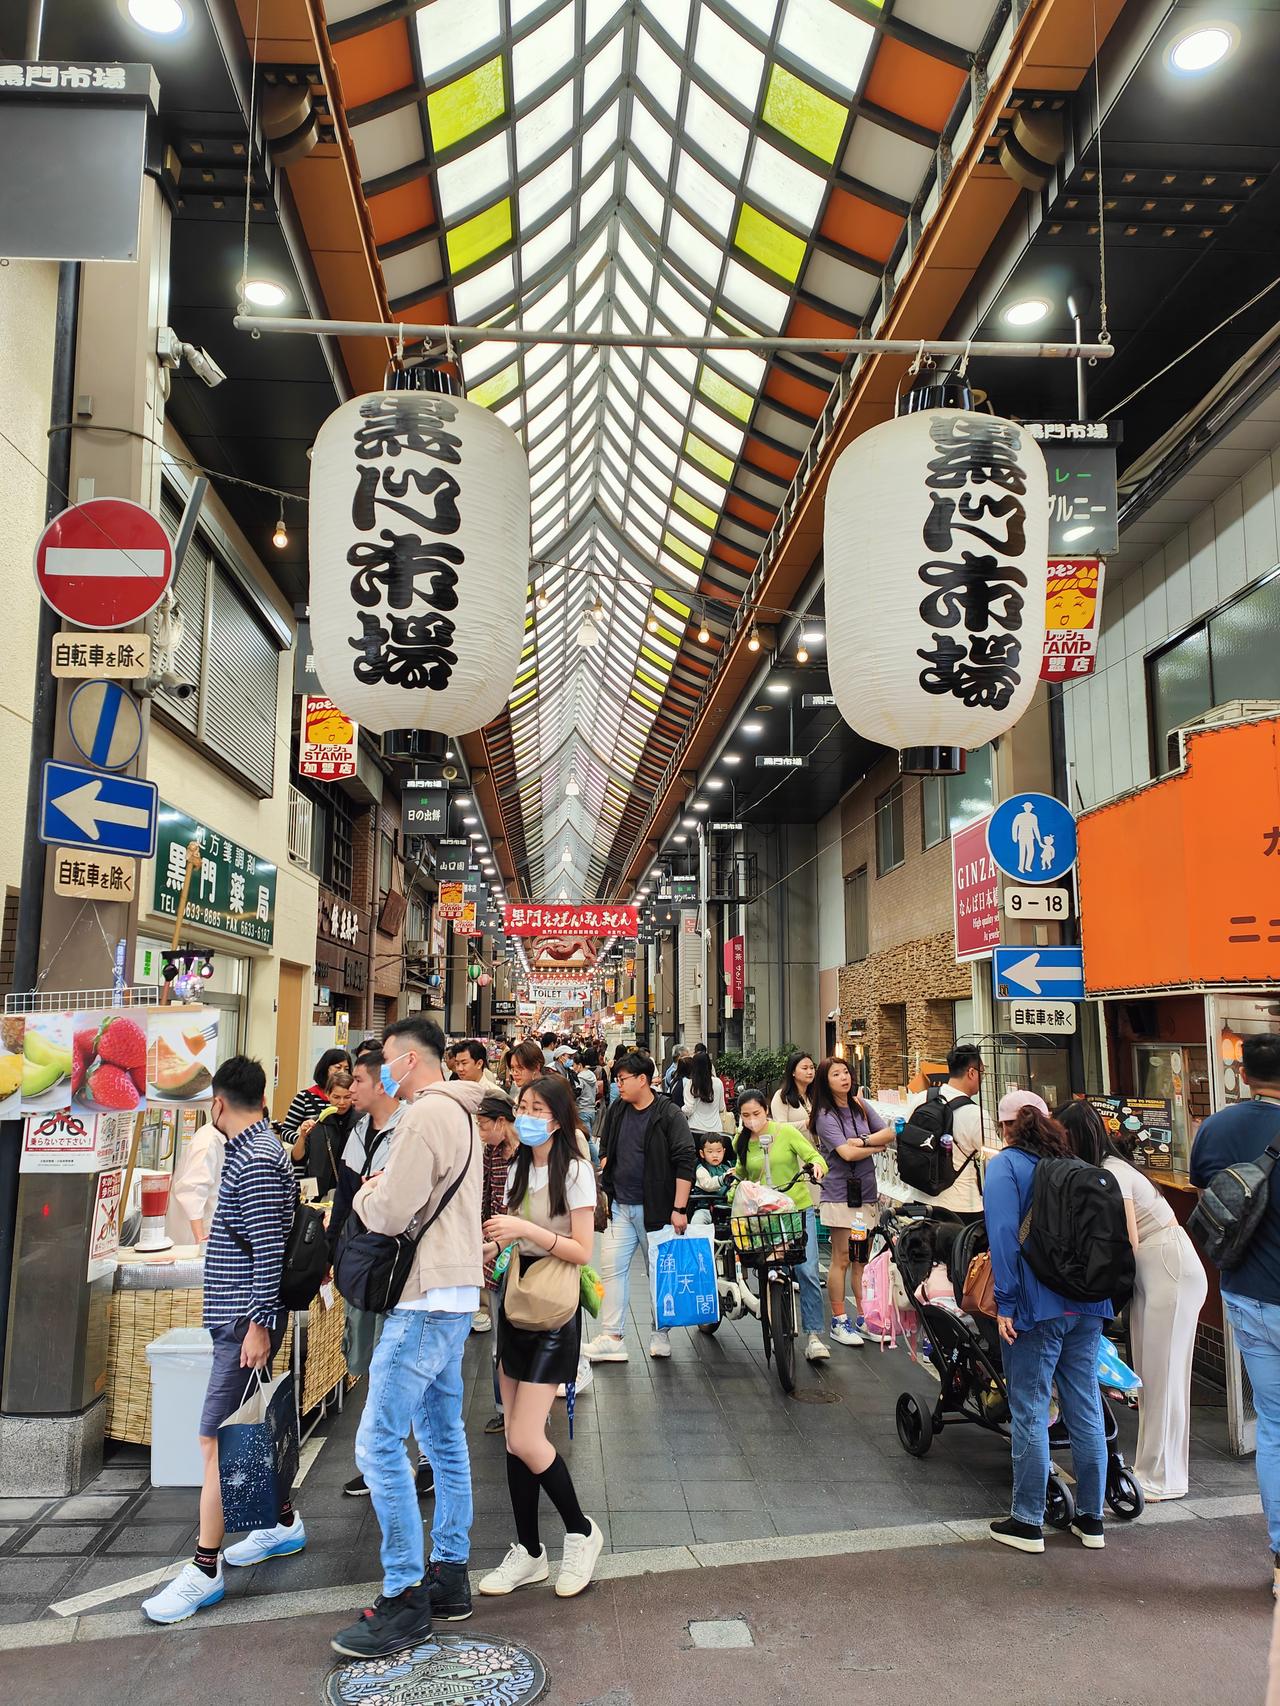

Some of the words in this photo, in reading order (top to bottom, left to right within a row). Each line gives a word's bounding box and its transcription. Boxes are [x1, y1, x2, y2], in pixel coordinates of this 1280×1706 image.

[0, 65, 126, 89] 黒門市場
[1024, 423, 1109, 439] 黒門市場
[347, 396, 465, 691] 黒門市場
[917, 416, 1028, 711] 黒門市場
[56, 643, 145, 668] 自転車を除く
[1048, 657, 1091, 672] 盟店
[305, 751, 353, 761] STAMP
[309, 744, 347, 752] フレッシュ
[304, 763, 353, 774] 加盟店
[60, 860, 132, 891] 自転車を除く
[958, 857, 996, 890] GINZA
[160, 893, 176, 914] TEL
[183, 901, 221, 927] 633-8685
[226, 916, 238, 933] FAX
[533, 989, 562, 998] TOILET
[1015, 1009, 1073, 1026] 自転車を除く
[1092, 1101, 1116, 1111] anese
